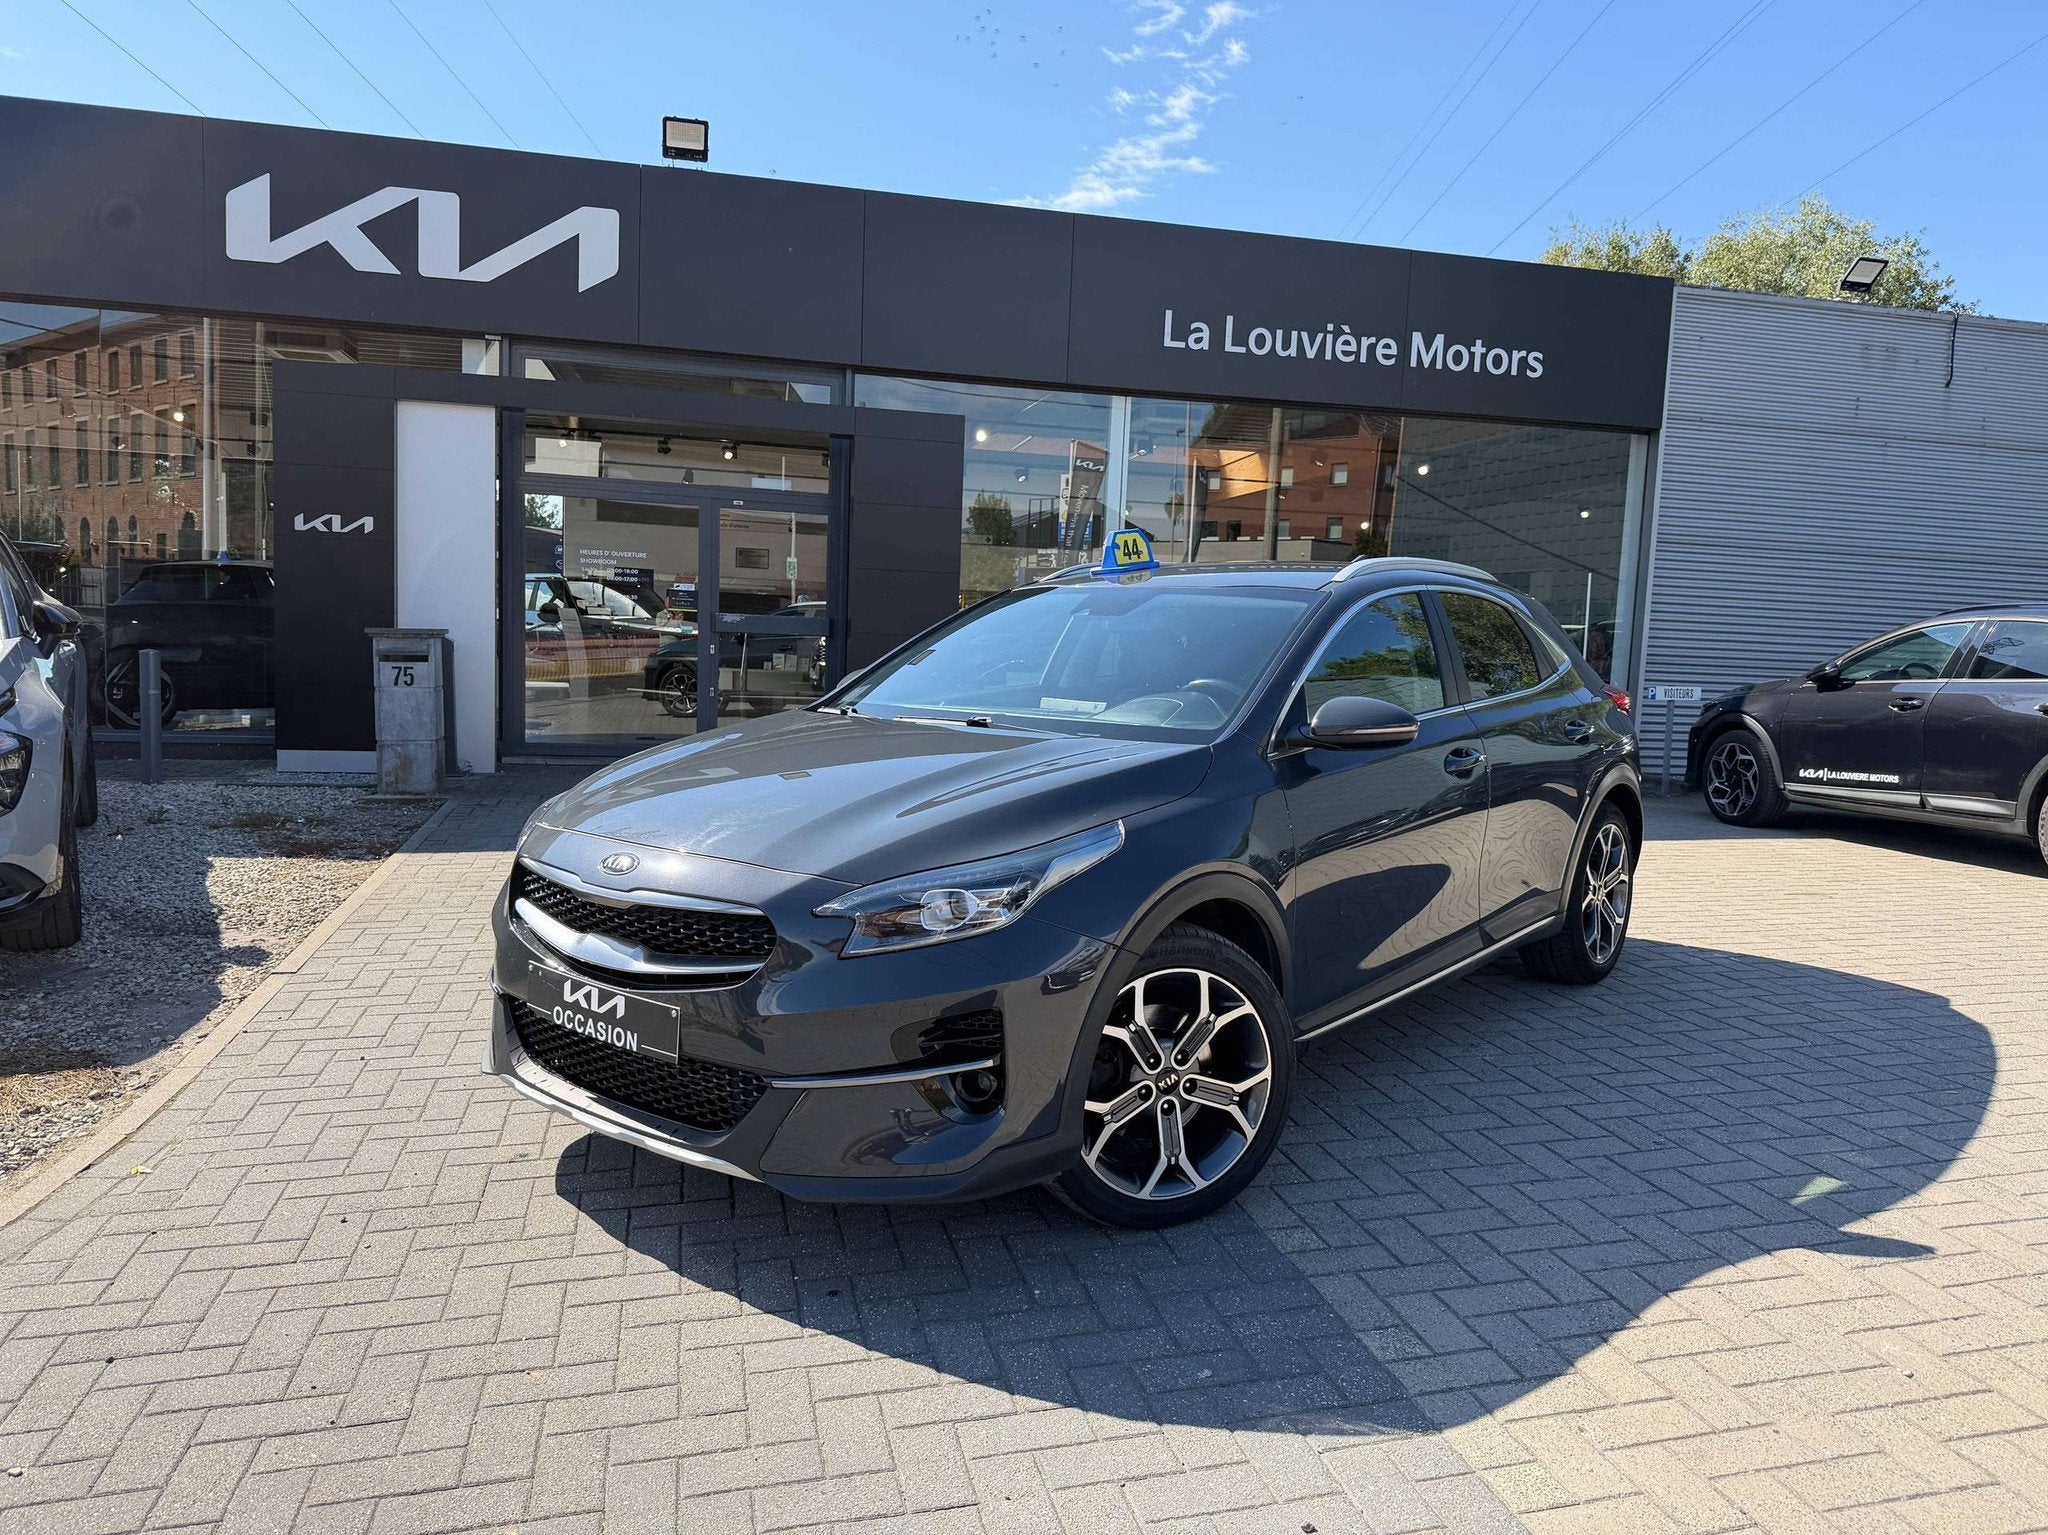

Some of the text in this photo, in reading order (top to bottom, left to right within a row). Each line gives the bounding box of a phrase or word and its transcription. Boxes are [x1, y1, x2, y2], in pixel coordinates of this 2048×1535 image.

[225, 172, 620, 293] KIA
[1163, 309, 1544, 379] La Louvière Motors
[294, 512, 374, 534] KIA
[579, 548, 604, 557] HEURES
[611, 551, 648, 559] OUVERTURE
[1122, 538, 1142, 560] 44
[391, 666, 415, 687] 75
[1663, 687, 1694, 700] VISITEURS
[1827, 770, 1836, 779] LA
[1836, 771, 1869, 781] LOUVIERE
[1869, 773, 1900, 784] MOTORS
[603, 854, 636, 871] KIA
[563, 978, 626, 1020] KIA
[553, 1005, 638, 1052] OCCASION
[1157, 1073, 1179, 1091] KIA
